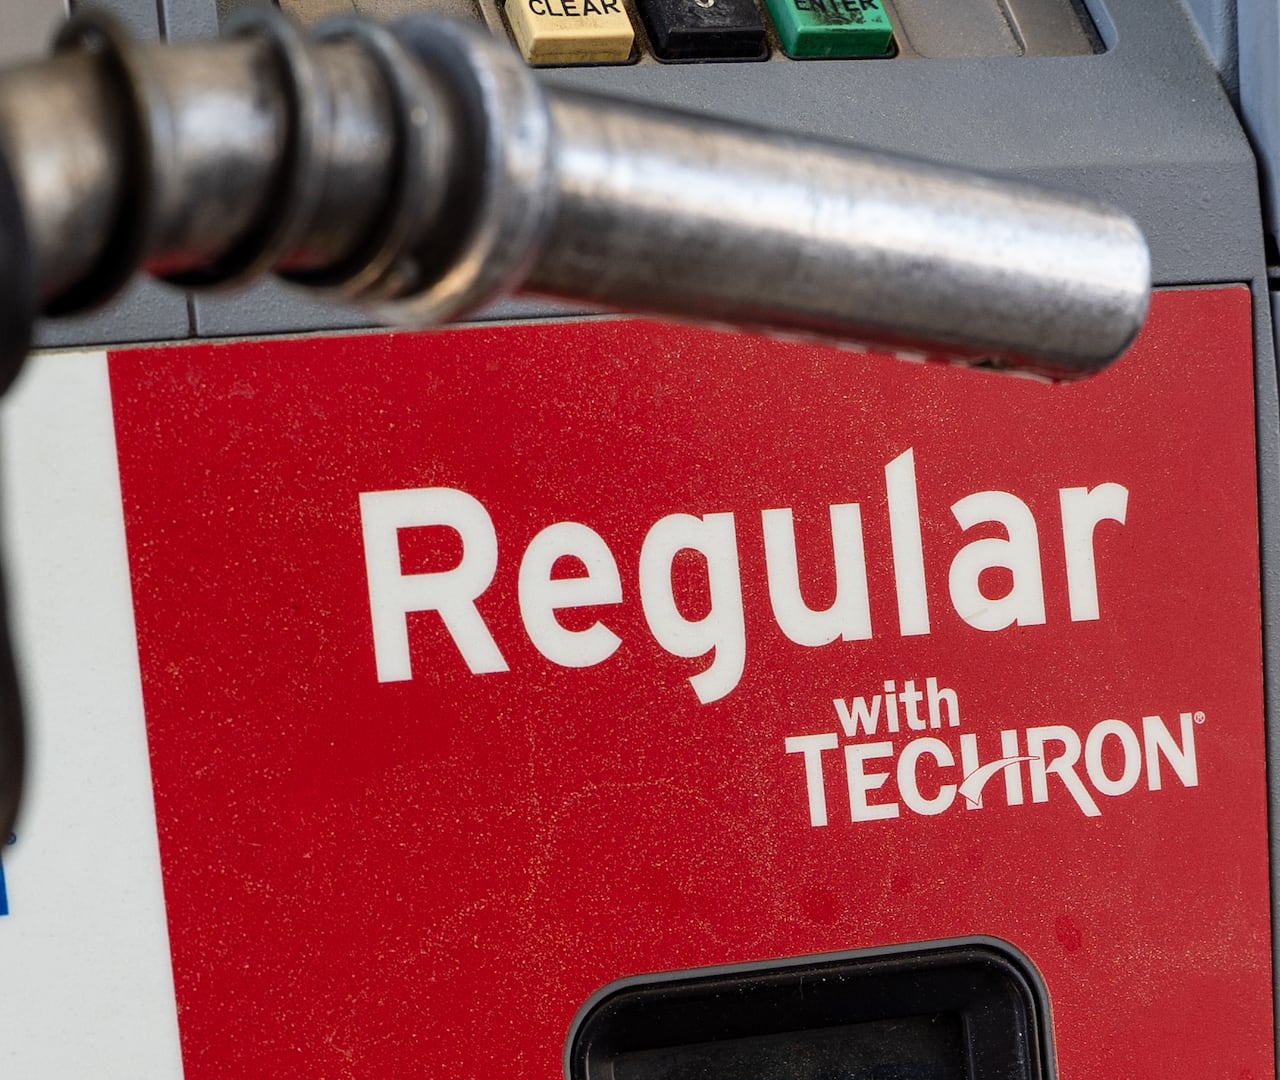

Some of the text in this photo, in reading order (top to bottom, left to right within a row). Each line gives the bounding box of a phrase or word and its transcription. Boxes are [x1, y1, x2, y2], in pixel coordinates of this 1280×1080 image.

[528, 0, 621, 17] CLEAR
[359, 447, 1129, 705] Regular
[833, 678, 960, 738] with
